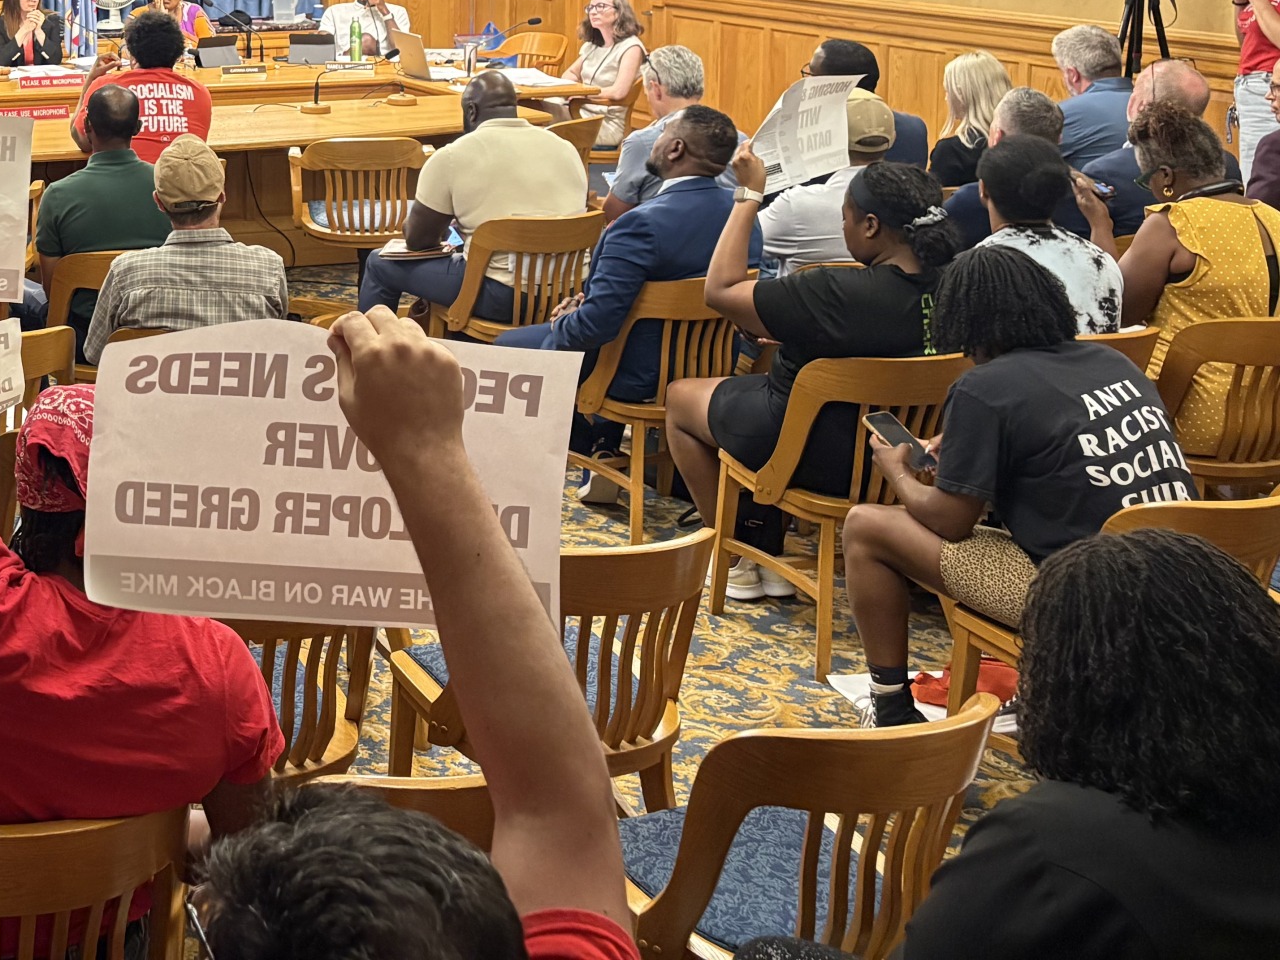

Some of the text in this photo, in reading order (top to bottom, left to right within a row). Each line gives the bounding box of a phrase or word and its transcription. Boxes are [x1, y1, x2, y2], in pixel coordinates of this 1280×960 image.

[52, 77, 83, 85] MICROPHONE
[128, 83, 195, 101] SOCIALISM
[20, 109, 31, 117] USE
[32, 107, 67, 116] MICROPHONE
[143, 99, 184, 115] IS THE
[140, 116, 189, 132] FUTURE
[1080, 379, 1143, 421] ANTI
[1077, 405, 1171, 457] RACIST
[1085, 439, 1192, 487] SOCIAL
